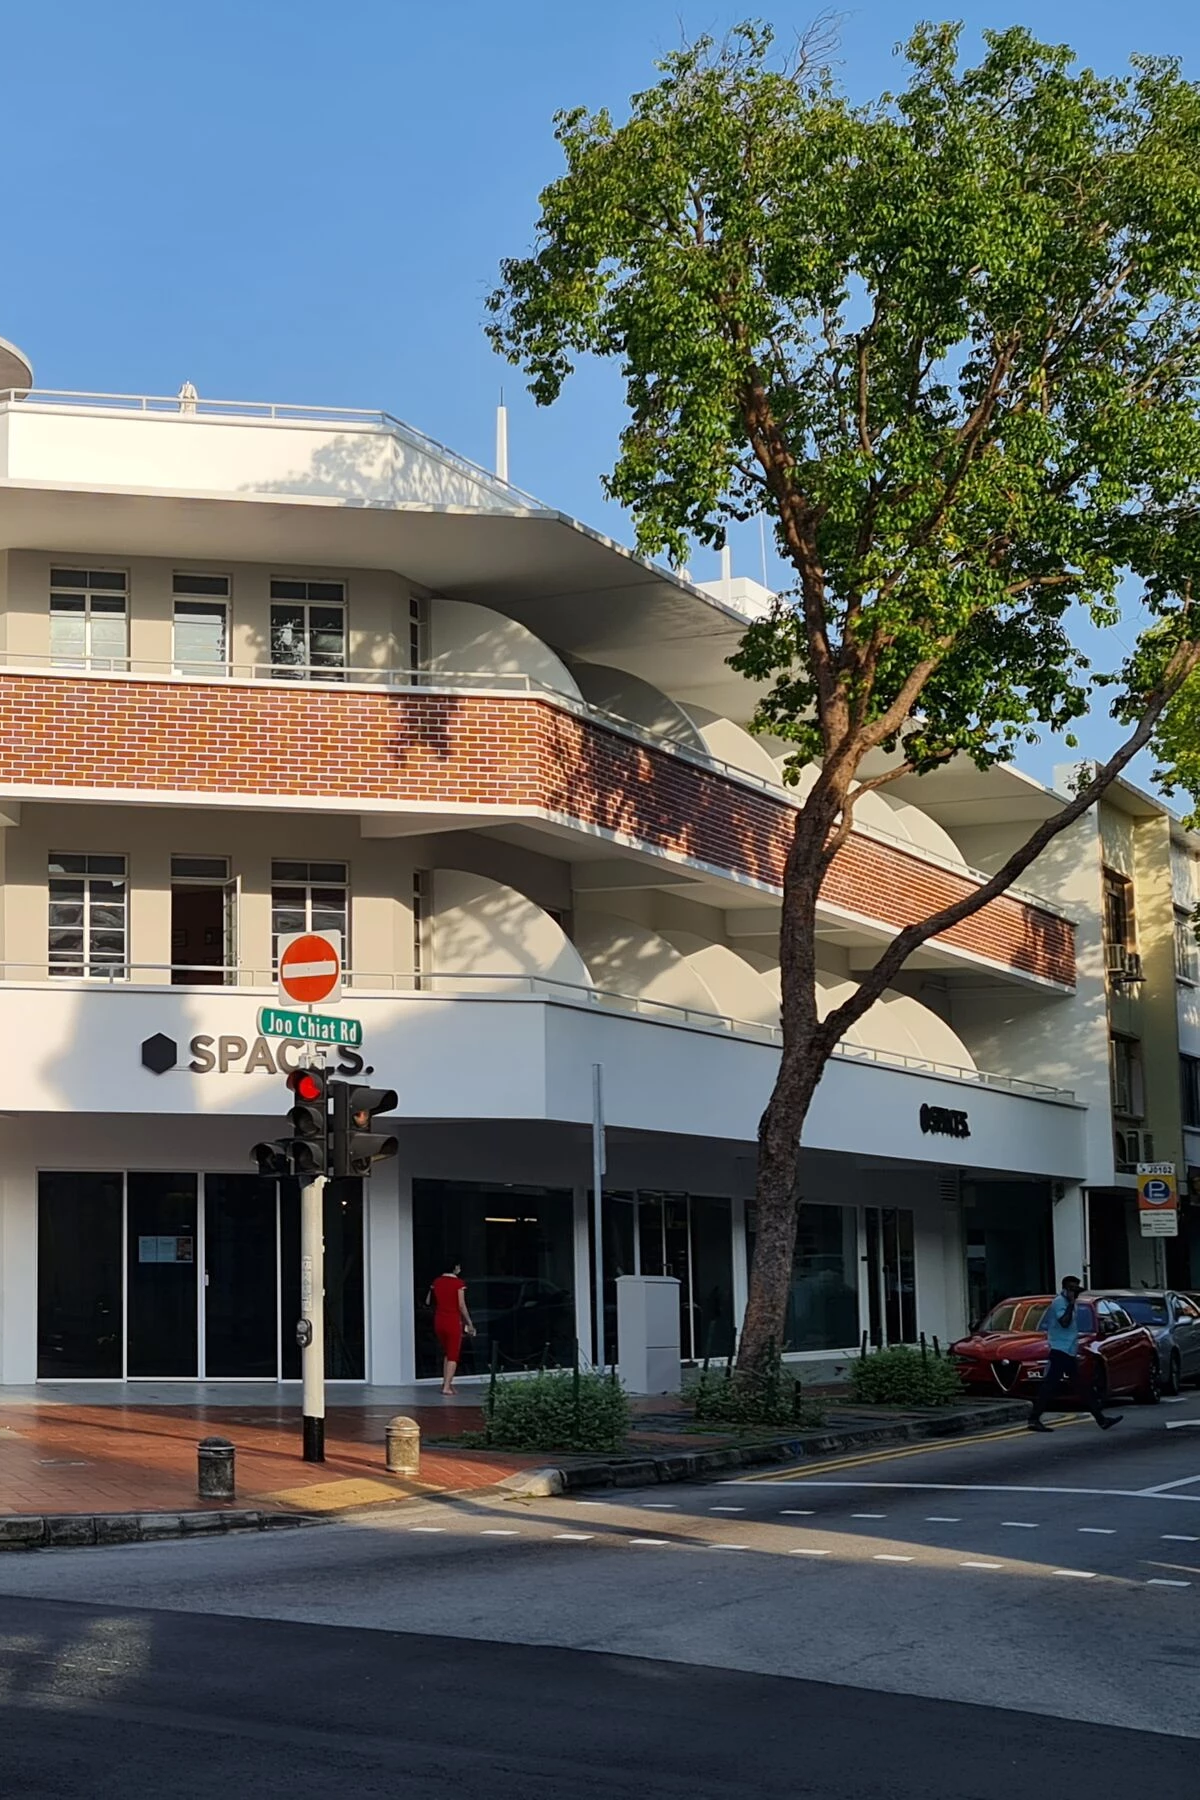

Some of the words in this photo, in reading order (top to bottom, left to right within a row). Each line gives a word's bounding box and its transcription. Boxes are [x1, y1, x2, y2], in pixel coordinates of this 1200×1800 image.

[268, 1011, 293, 1034] Joo
[298, 1015, 336, 1040] Chiat
[340, 1021, 357, 1042] Rd
[1148, 1181, 1166, 1198] P
